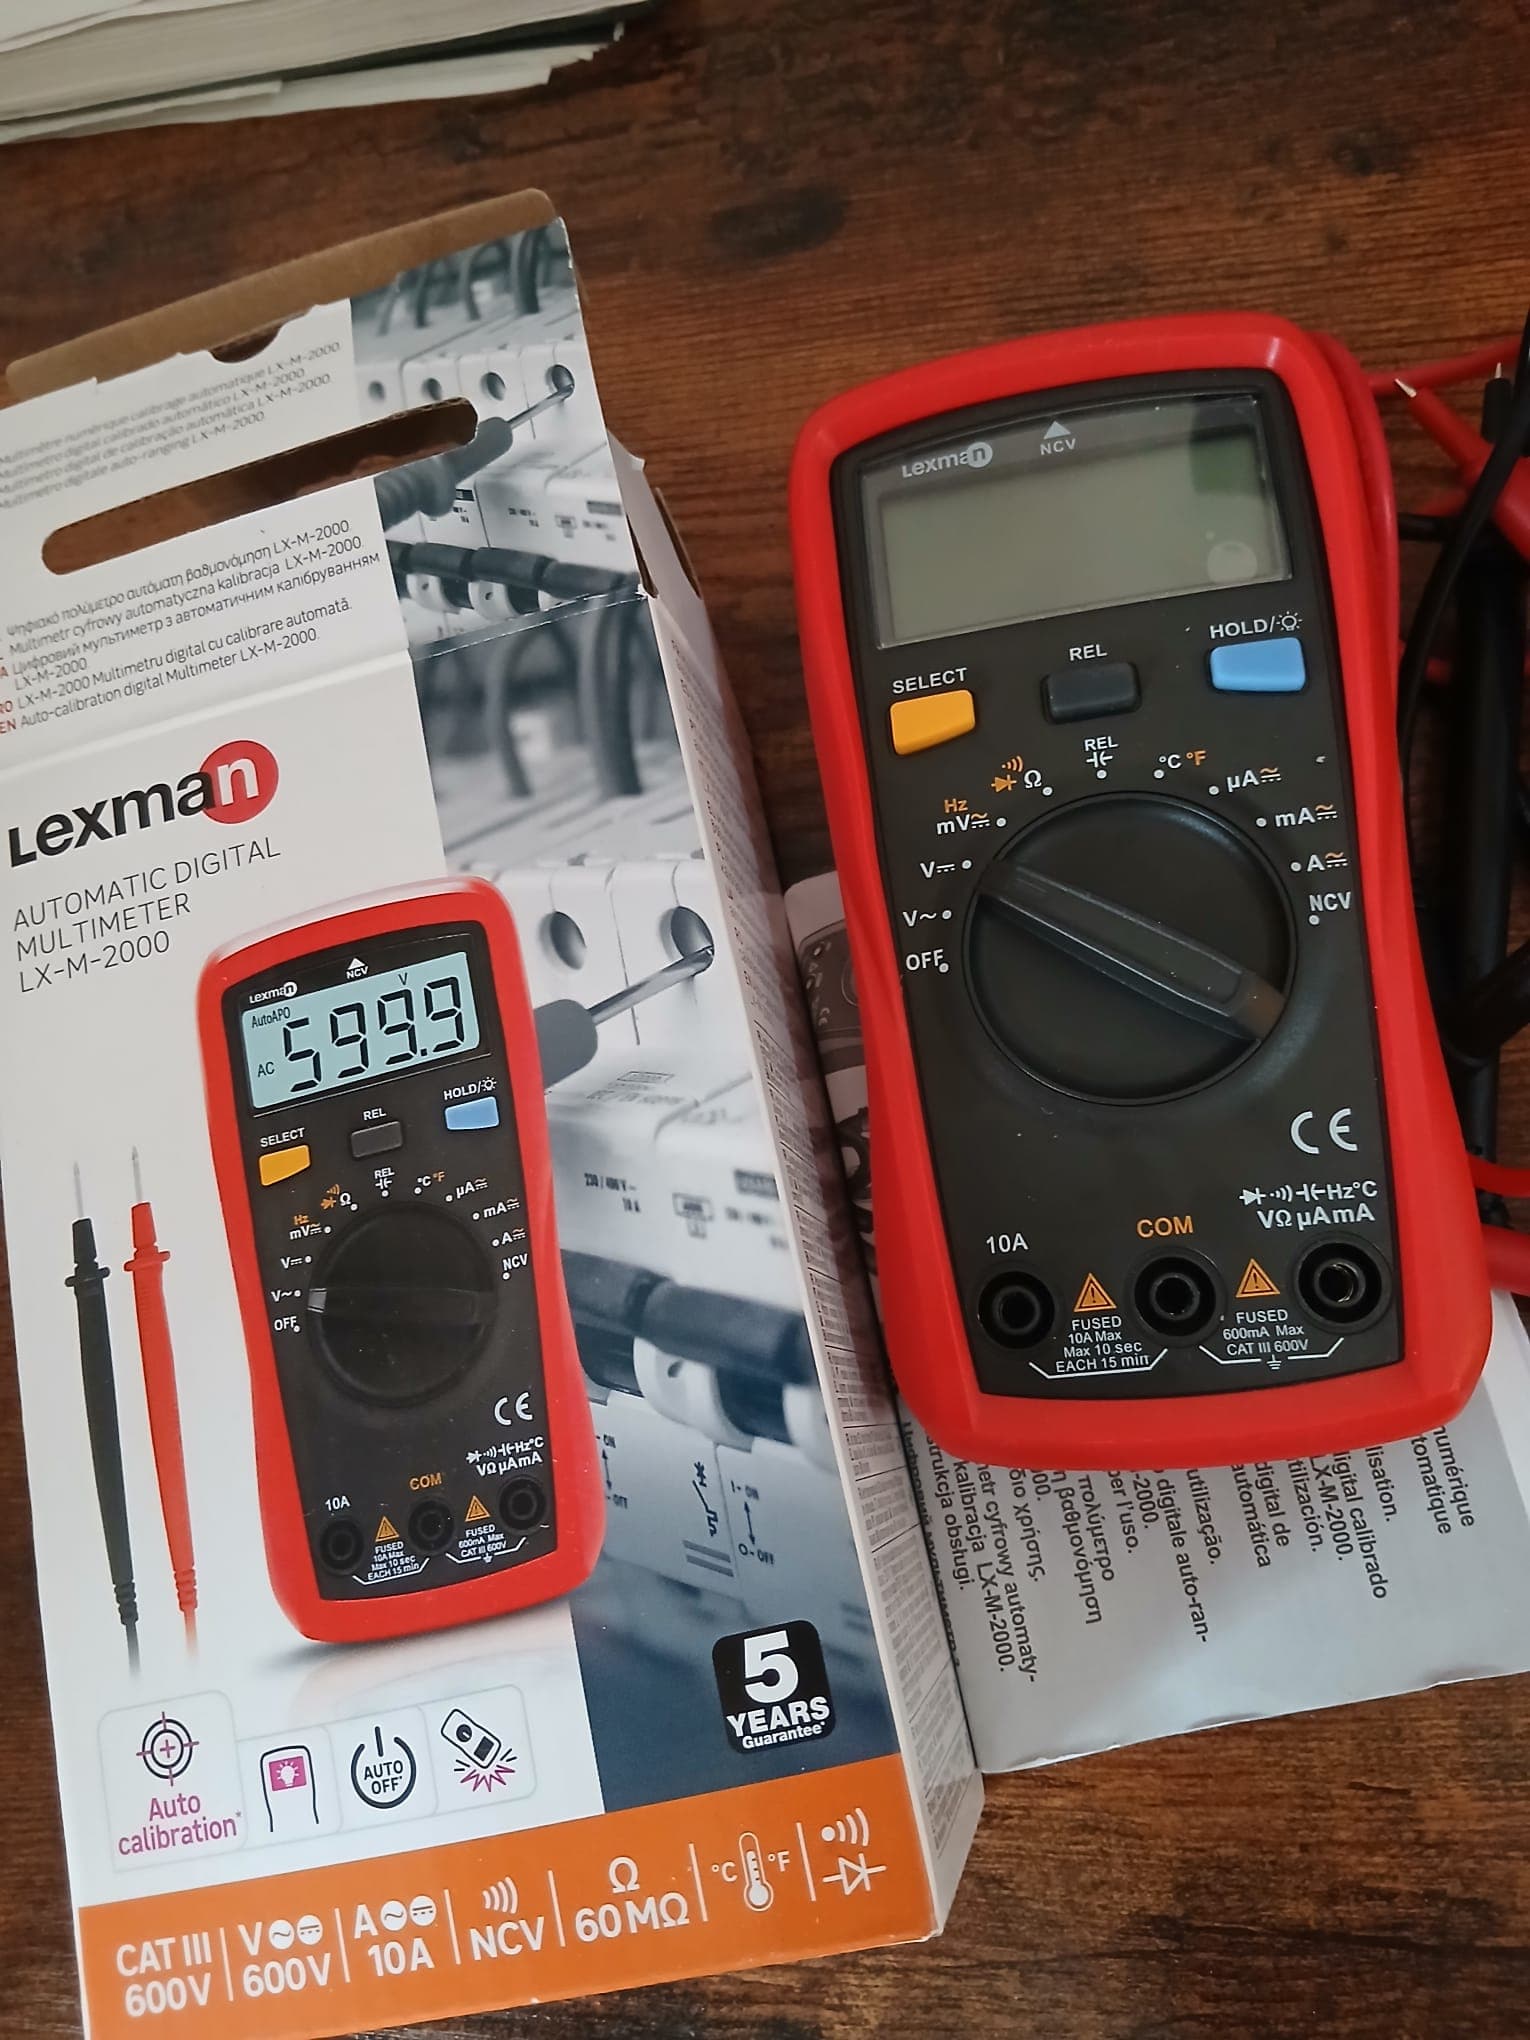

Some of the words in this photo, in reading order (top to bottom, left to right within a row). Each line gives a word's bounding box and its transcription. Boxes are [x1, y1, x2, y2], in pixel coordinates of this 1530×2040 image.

[1040, 438, 1077, 456] NCV
[901, 441, 993, 478] Lexman
[186, 546, 271, 582] βαθμονόμηση
[9, 629, 70, 655] Multimetr
[73, 613, 122, 637] cyfrowy
[126, 586, 215, 620] automatyczna
[217, 564, 280, 591] kalibracja
[13, 644, 81, 675] Цифровий
[83, 620, 163, 652] мультиметр
[176, 585, 274, 626] автоматичним
[277, 553, 380, 592] калібруванням
[1069, 644, 1108, 662] REL
[15, 657, 88, 691] LX-M-2000
[18, 676, 91, 709] LX-M-2000
[93, 656, 164, 685] Multimetru
[165, 640, 206, 663] digital
[208, 637, 224, 651] cu
[226, 620, 284, 646] calibrare
[21, 687, 122, 728] Auto-calibration
[124, 674, 164, 696] digital
[166, 652, 237, 684] Multimeter
[892, 667, 968, 695] SELECT
[1084, 736, 1119, 752] REL
[1158, 753, 1182, 769] °C
[1186, 750, 1207, 766] °F
[8, 755, 262, 868] Lexman
[943, 799, 969, 813] Hz
[1274, 807, 1316, 828] mA
[14, 867, 167, 932] AUTOMATIC
[175, 837, 281, 885] DIGITAL
[1309, 891, 1352, 913] NCV
[18, 893, 190, 962] MULTIMETER
[20, 930, 170, 993] LX-M-2000
[905, 949, 944, 972] OFF
[346, 965, 369, 980] NCV
[398, 972, 409, 987] V
[249, 982, 297, 1004] Lexman
[251, 1007, 291, 1029] AutoAPO
[282, 976, 465, 1093] 599.9
[257, 1061, 275, 1078] AC
[363, 1107, 387, 1121] REL
[260, 1128, 305, 1148] SELECT
[1289, 1107, 1358, 1154] CE
[374, 1166, 395, 1180] REL
[293, 1214, 310, 1226] Hz
[483, 1202, 507, 1219] mA
[1136, 1215, 1194, 1239] COM
[985, 1233, 1029, 1255] 10A
[502, 1253, 528, 1271] NCV
[274, 1315, 297, 1331] OFF
[1072, 1316, 1122, 1331] FUSED
[1235, 1309, 1288, 1324] FUSED
[1068, 1332, 1093, 1344] 10A
[1095, 1331, 1122, 1342] Max
[1223, 1326, 1270, 1340] 600mA
[1275, 1324, 1304, 1337] Max
[1063, 1346, 1091, 1358] Max
[1095, 1343, 1111, 1355] 10
[1115, 1342, 1142, 1354] sec
[1226, 1342, 1254, 1356] CAT
[1258, 1341, 1271, 1353] III
[1274, 1338, 1309, 1352] 600V
[1056, 1358, 1097, 1373] EACH
[1101, 1356, 1118, 1369] 15
[1121, 1353, 1150, 1367] min
[494, 1392, 533, 1426] CE
[409, 1472, 442, 1491] COM
[325, 1495, 350, 1511] 10A
[1309, 1455, 1354, 1562] LX-M-2000.
[1078, 1474, 1115, 1581] πολύμετρο
[1186, 1469, 1223, 1565] utilização.
[465, 1524, 495, 1538] FUSED
[1271, 1521, 1291, 1547] de
[375, 1541, 404, 1554] FUSED
[458, 1536, 486, 1549] 600mA
[461, 1547, 477, 1557] CAT
[944, 1513, 975, 1591] obsługi.
[1013, 1502, 1046, 1583] χρήσης.
[1350, 1507, 1389, 1600] calibrado
[389, 1559, 398, 1567] 10
[399, 1555, 416, 1565] sec
[953, 1460, 985, 1553] kalibracja
[976, 1561, 1014, 1673] LX-M-2000.
[1054, 1487, 1102, 1625] βαθμονόμηση
[1157, 1478, 1186, 1549] digitale
[1176, 1553, 1209, 1643] auto-ran-
[367, 1570, 391, 1581] EACH
[393, 1566, 402, 1575] 15
[403, 1562, 419, 1572] min
[983, 1499, 1014, 1578] cyfrowy
[1004, 1582, 1038, 1683] automaty-
[744, 1630, 799, 1704] 5
[727, 1696, 830, 1737] YEARS
[364, 1759, 403, 1781] AUTO
[148, 1792, 201, 1822] Auto
[711, 1861, 738, 1883] °C
[768, 1850, 790, 1872] °F
[470, 1916, 545, 1961] NCV
[116, 1937, 176, 1977] CAT
[182, 1932, 213, 1967] III
[368, 1938, 435, 1977] 10A
[243, 1953, 331, 1997] 600V
[125, 1973, 212, 2018] 600V
